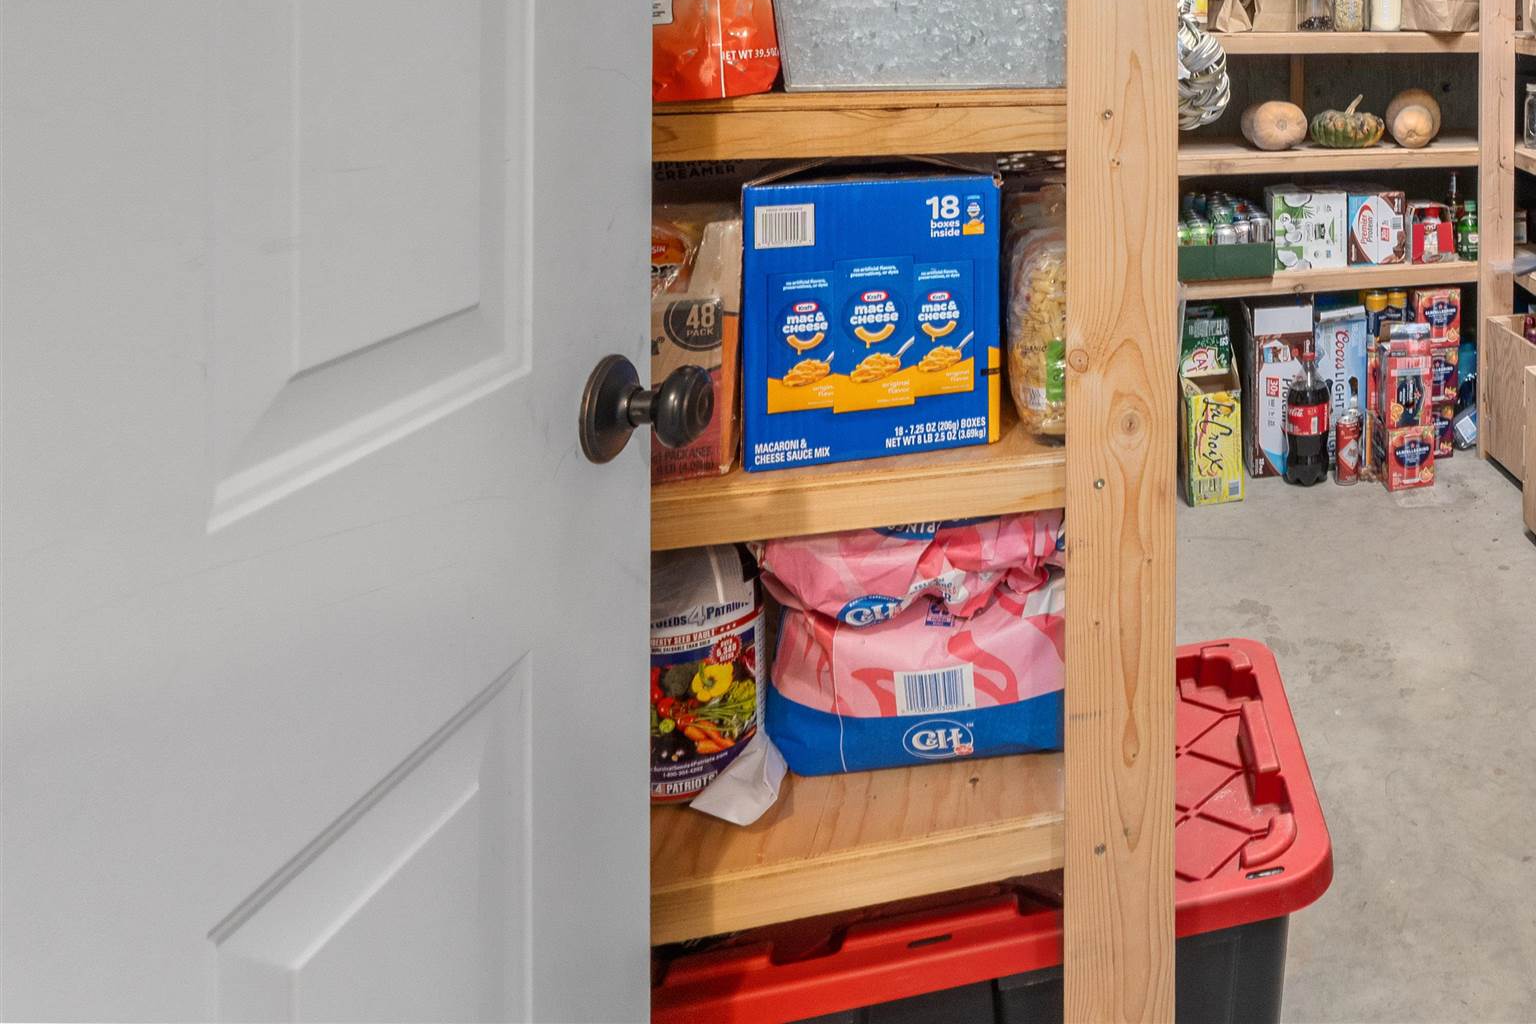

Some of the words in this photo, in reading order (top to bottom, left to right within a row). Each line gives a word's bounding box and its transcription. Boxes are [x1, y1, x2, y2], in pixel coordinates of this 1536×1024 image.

[737, 48, 754, 60] WT
[655, 164, 735, 180] CREAMER
[925, 194, 961, 220] 18
[930, 219, 960, 228] boxes
[1360, 214, 1370, 245] Premier
[930, 227, 961, 238] inside
[866, 293, 883, 301] Kraft
[854, 304, 885, 315] mac
[885, 301, 896, 313] &
[921, 303, 947, 312] mac
[947, 301, 957, 310] &
[686, 303, 715, 329] 48
[786, 314, 814, 324] mac
[815, 312, 825, 322] &
[687, 327, 714, 337] PACK
[1335, 329, 1350, 372] Coors
[882, 379, 910, 389] original
[887, 386, 910, 394] flavor
[1334, 371, 1345, 409] LIGHT
[895, 426, 904, 437] 18
[909, 424, 925, 435] 7.25
[926, 423, 936, 433] OZ
[937, 420, 960, 434] (206g)
[960, 416, 986, 428] BOXES
[886, 437, 901, 448] NET
[903, 436, 916, 447] WT
[917, 435, 922, 445] 8
[923, 434, 933, 444] LB
[934, 432, 945, 443] 2.5
[946, 430, 957, 442] OZ
[958, 427, 986, 440] (3.69kg)
[754, 440, 799, 455] MACARONI
[800, 438, 808, 449] &
[754, 451, 786, 465] CHEESE
[786, 449, 813, 462] SAUCE
[814, 446, 830, 458] MIX
[674, 635, 692, 645] SEED
[692, 628, 715, 641] VAULT
[912, 728, 965, 751] C&H
